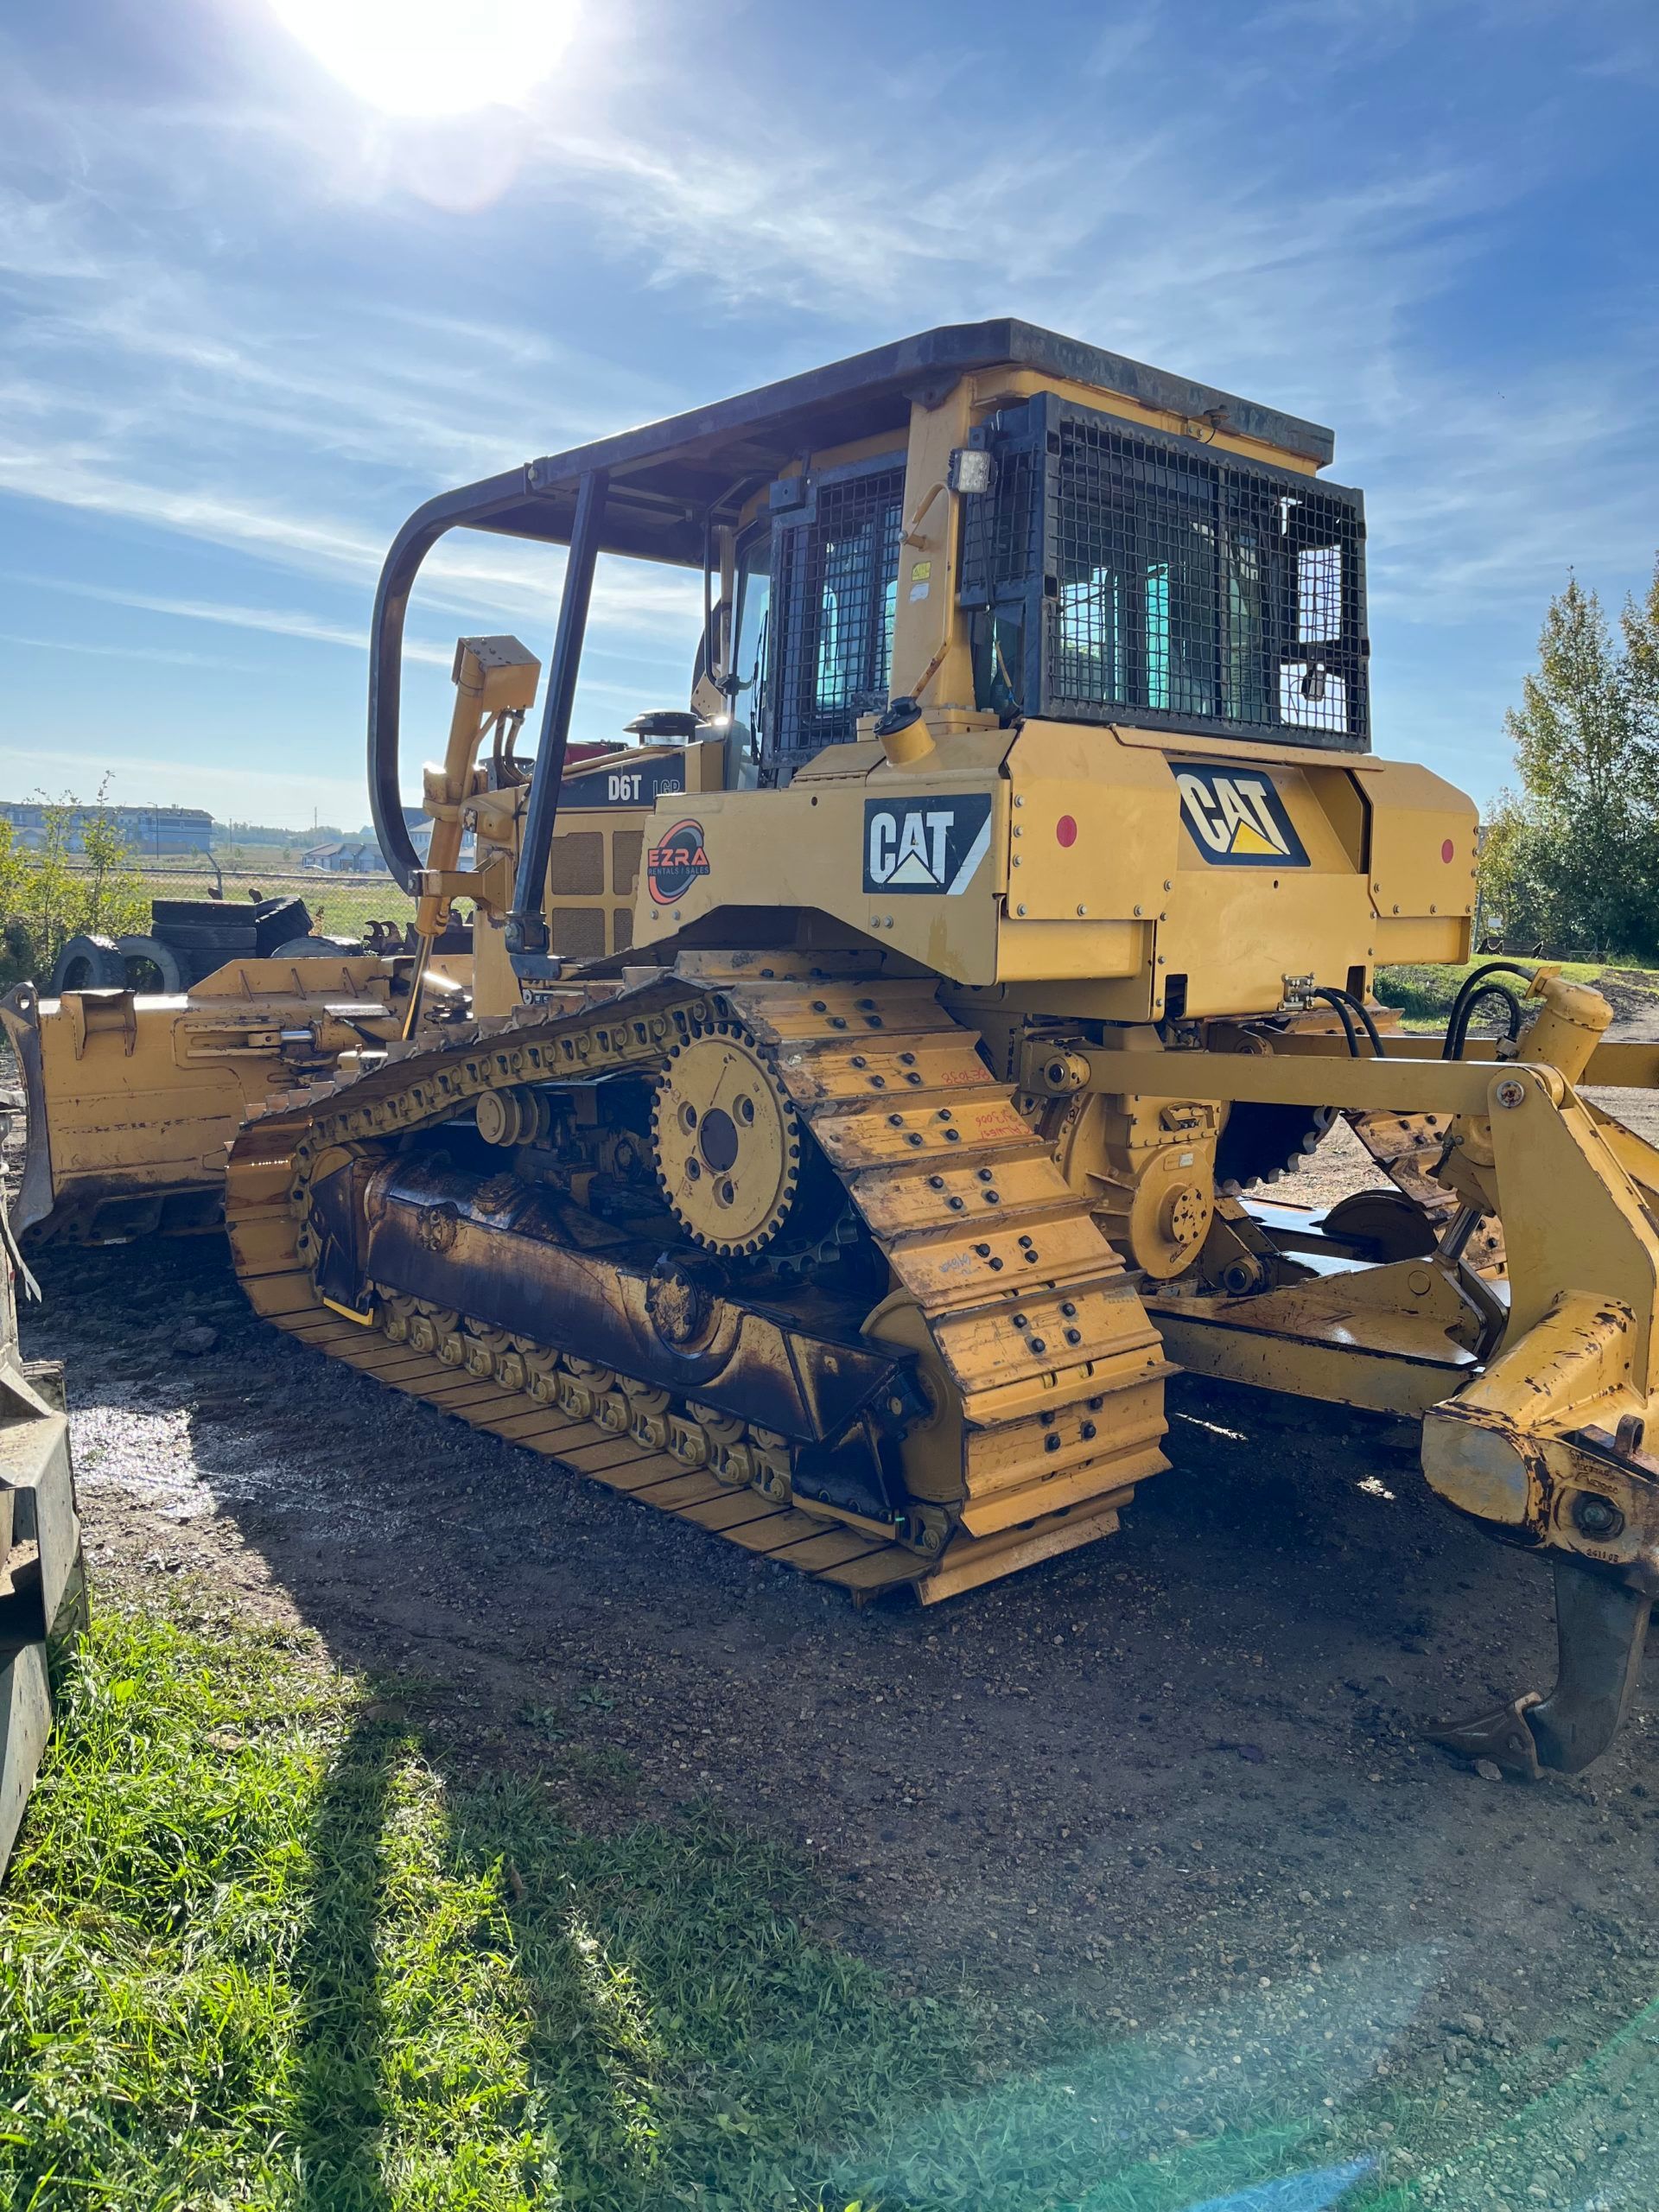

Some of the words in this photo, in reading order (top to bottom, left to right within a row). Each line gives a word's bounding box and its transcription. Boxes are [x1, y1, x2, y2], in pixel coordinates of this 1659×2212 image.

[608, 774, 642, 801] D6T
[1177, 773, 1291, 855] CAT
[649, 848, 709, 868] EZRA
[869, 810, 955, 884] CAT
[649, 867, 679, 875] RENTALS
[685, 866, 709, 874] SALES
